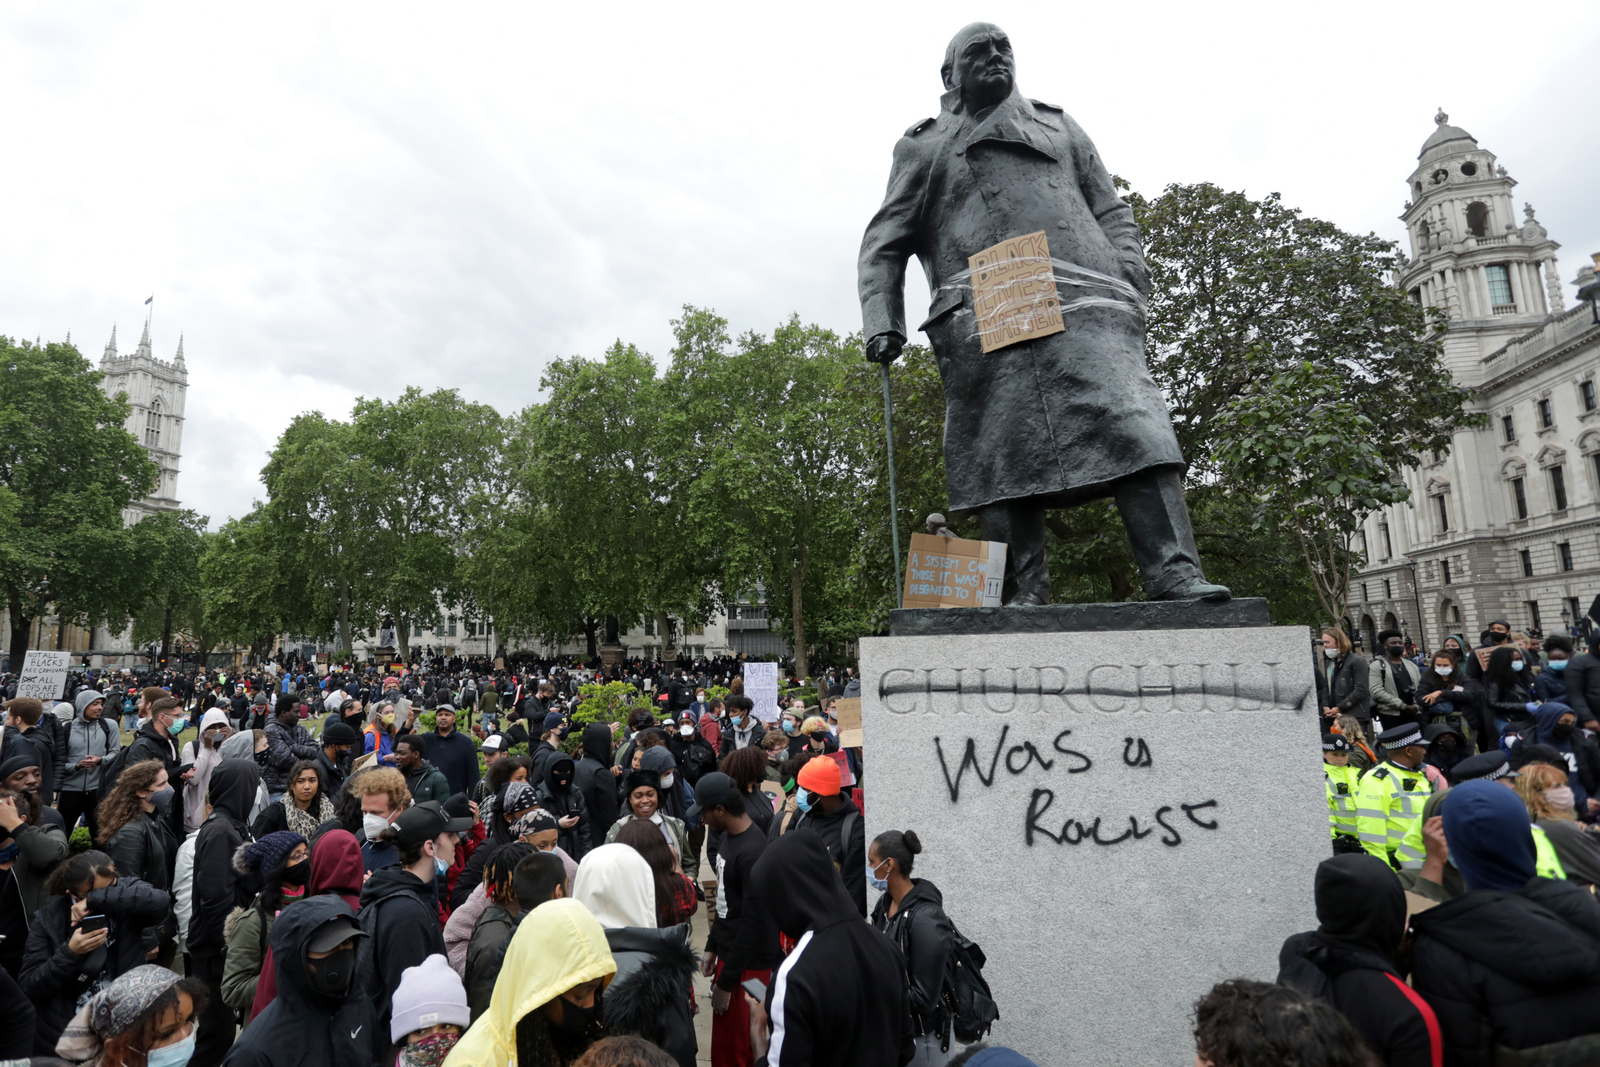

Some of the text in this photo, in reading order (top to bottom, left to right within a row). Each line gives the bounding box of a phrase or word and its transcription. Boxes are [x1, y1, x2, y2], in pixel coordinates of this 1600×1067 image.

[975, 233, 1050, 286] BLACK
[977, 266, 1056, 317] LIVES
[982, 297, 1063, 346] MATTER
[911, 553, 919, 568] A
[924, 554, 959, 570] SYSTEM
[910, 568, 935, 582] THOSE
[939, 571, 951, 583] IT
[954, 573, 978, 587] WAS
[909, 582, 953, 597] DESIGNED
[954, 586, 969, 599] TO
[30, 659, 64, 667] BLACKS
[748, 663, 773, 676] WE
[20, 684, 59, 692] COPS ARE
[745, 675, 778, 687] STAND
[879, 661, 1304, 715] CHURCHILL
[749, 688, 776, 699] WITH
[751, 697, 775, 714] YOU
[934, 724, 1153, 803] Was a
[1025, 788, 1219, 847] Racist
